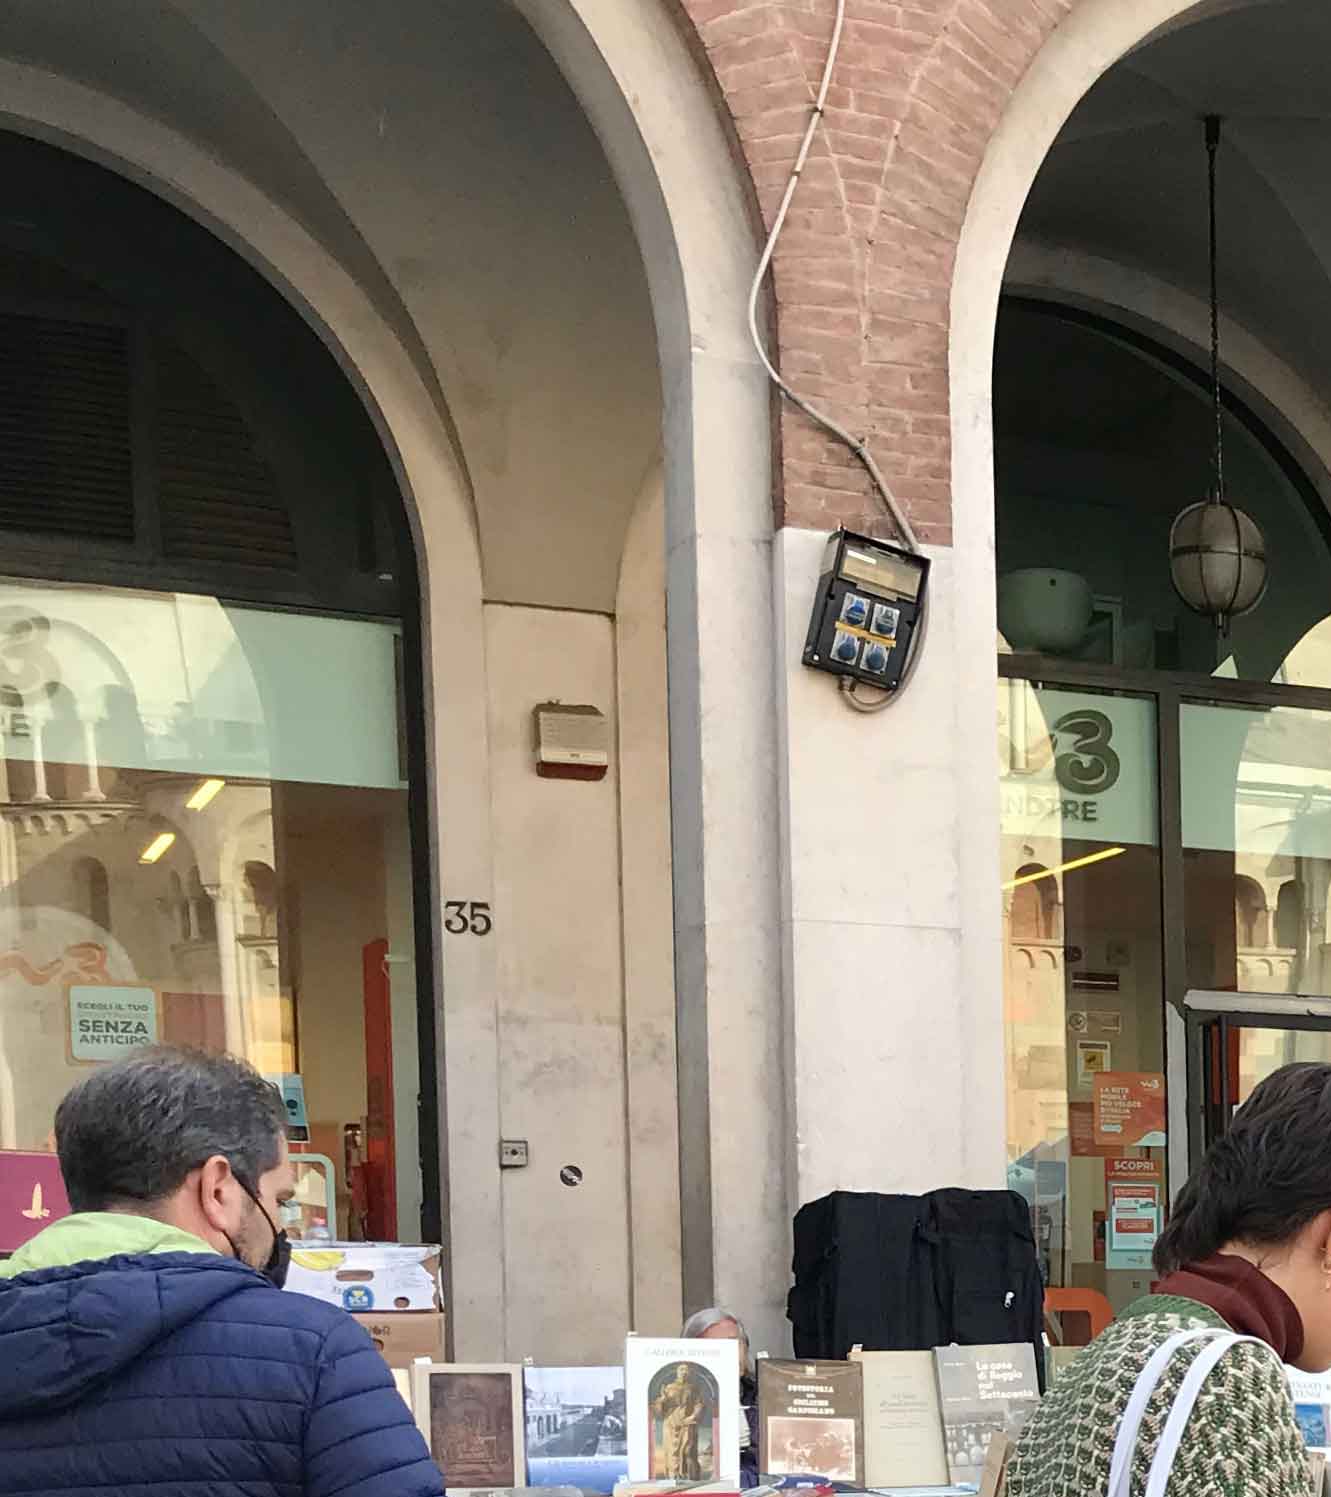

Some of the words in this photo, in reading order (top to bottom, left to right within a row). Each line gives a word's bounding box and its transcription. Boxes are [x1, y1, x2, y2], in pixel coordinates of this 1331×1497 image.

[444, 901, 493, 936] 35
[79, 1020, 148, 1034] SENZA
[79, 1034, 150, 1045] ANTICIPO
[1113, 1160, 1154, 1171] SCOPRI
